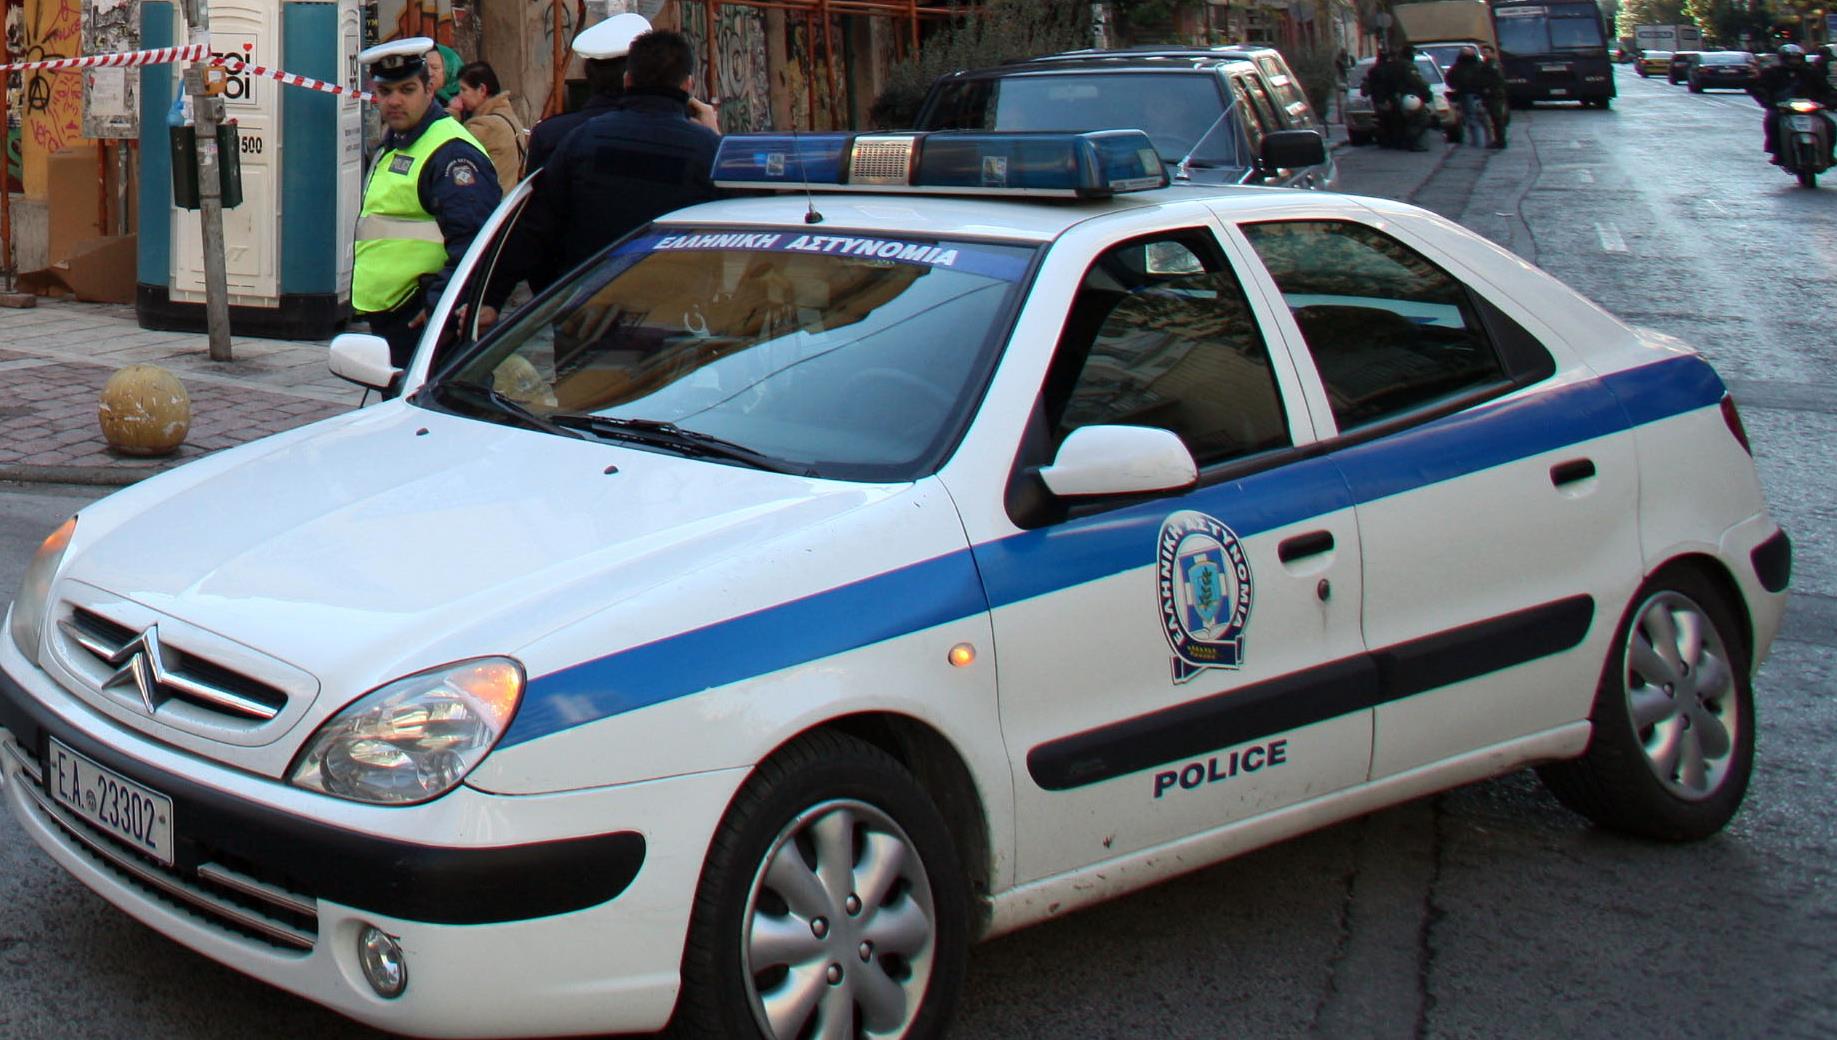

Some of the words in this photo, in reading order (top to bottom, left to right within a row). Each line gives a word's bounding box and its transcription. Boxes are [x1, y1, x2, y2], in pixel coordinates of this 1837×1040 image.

[653, 234, 782, 250] ΕΛΛΗΝΙΚΗ
[785, 234, 958, 266] ΑΣΤΥΝΟΜΙΑ
[1153, 739, 1288, 799] POLICE
[98, 773, 157, 849] 23302
